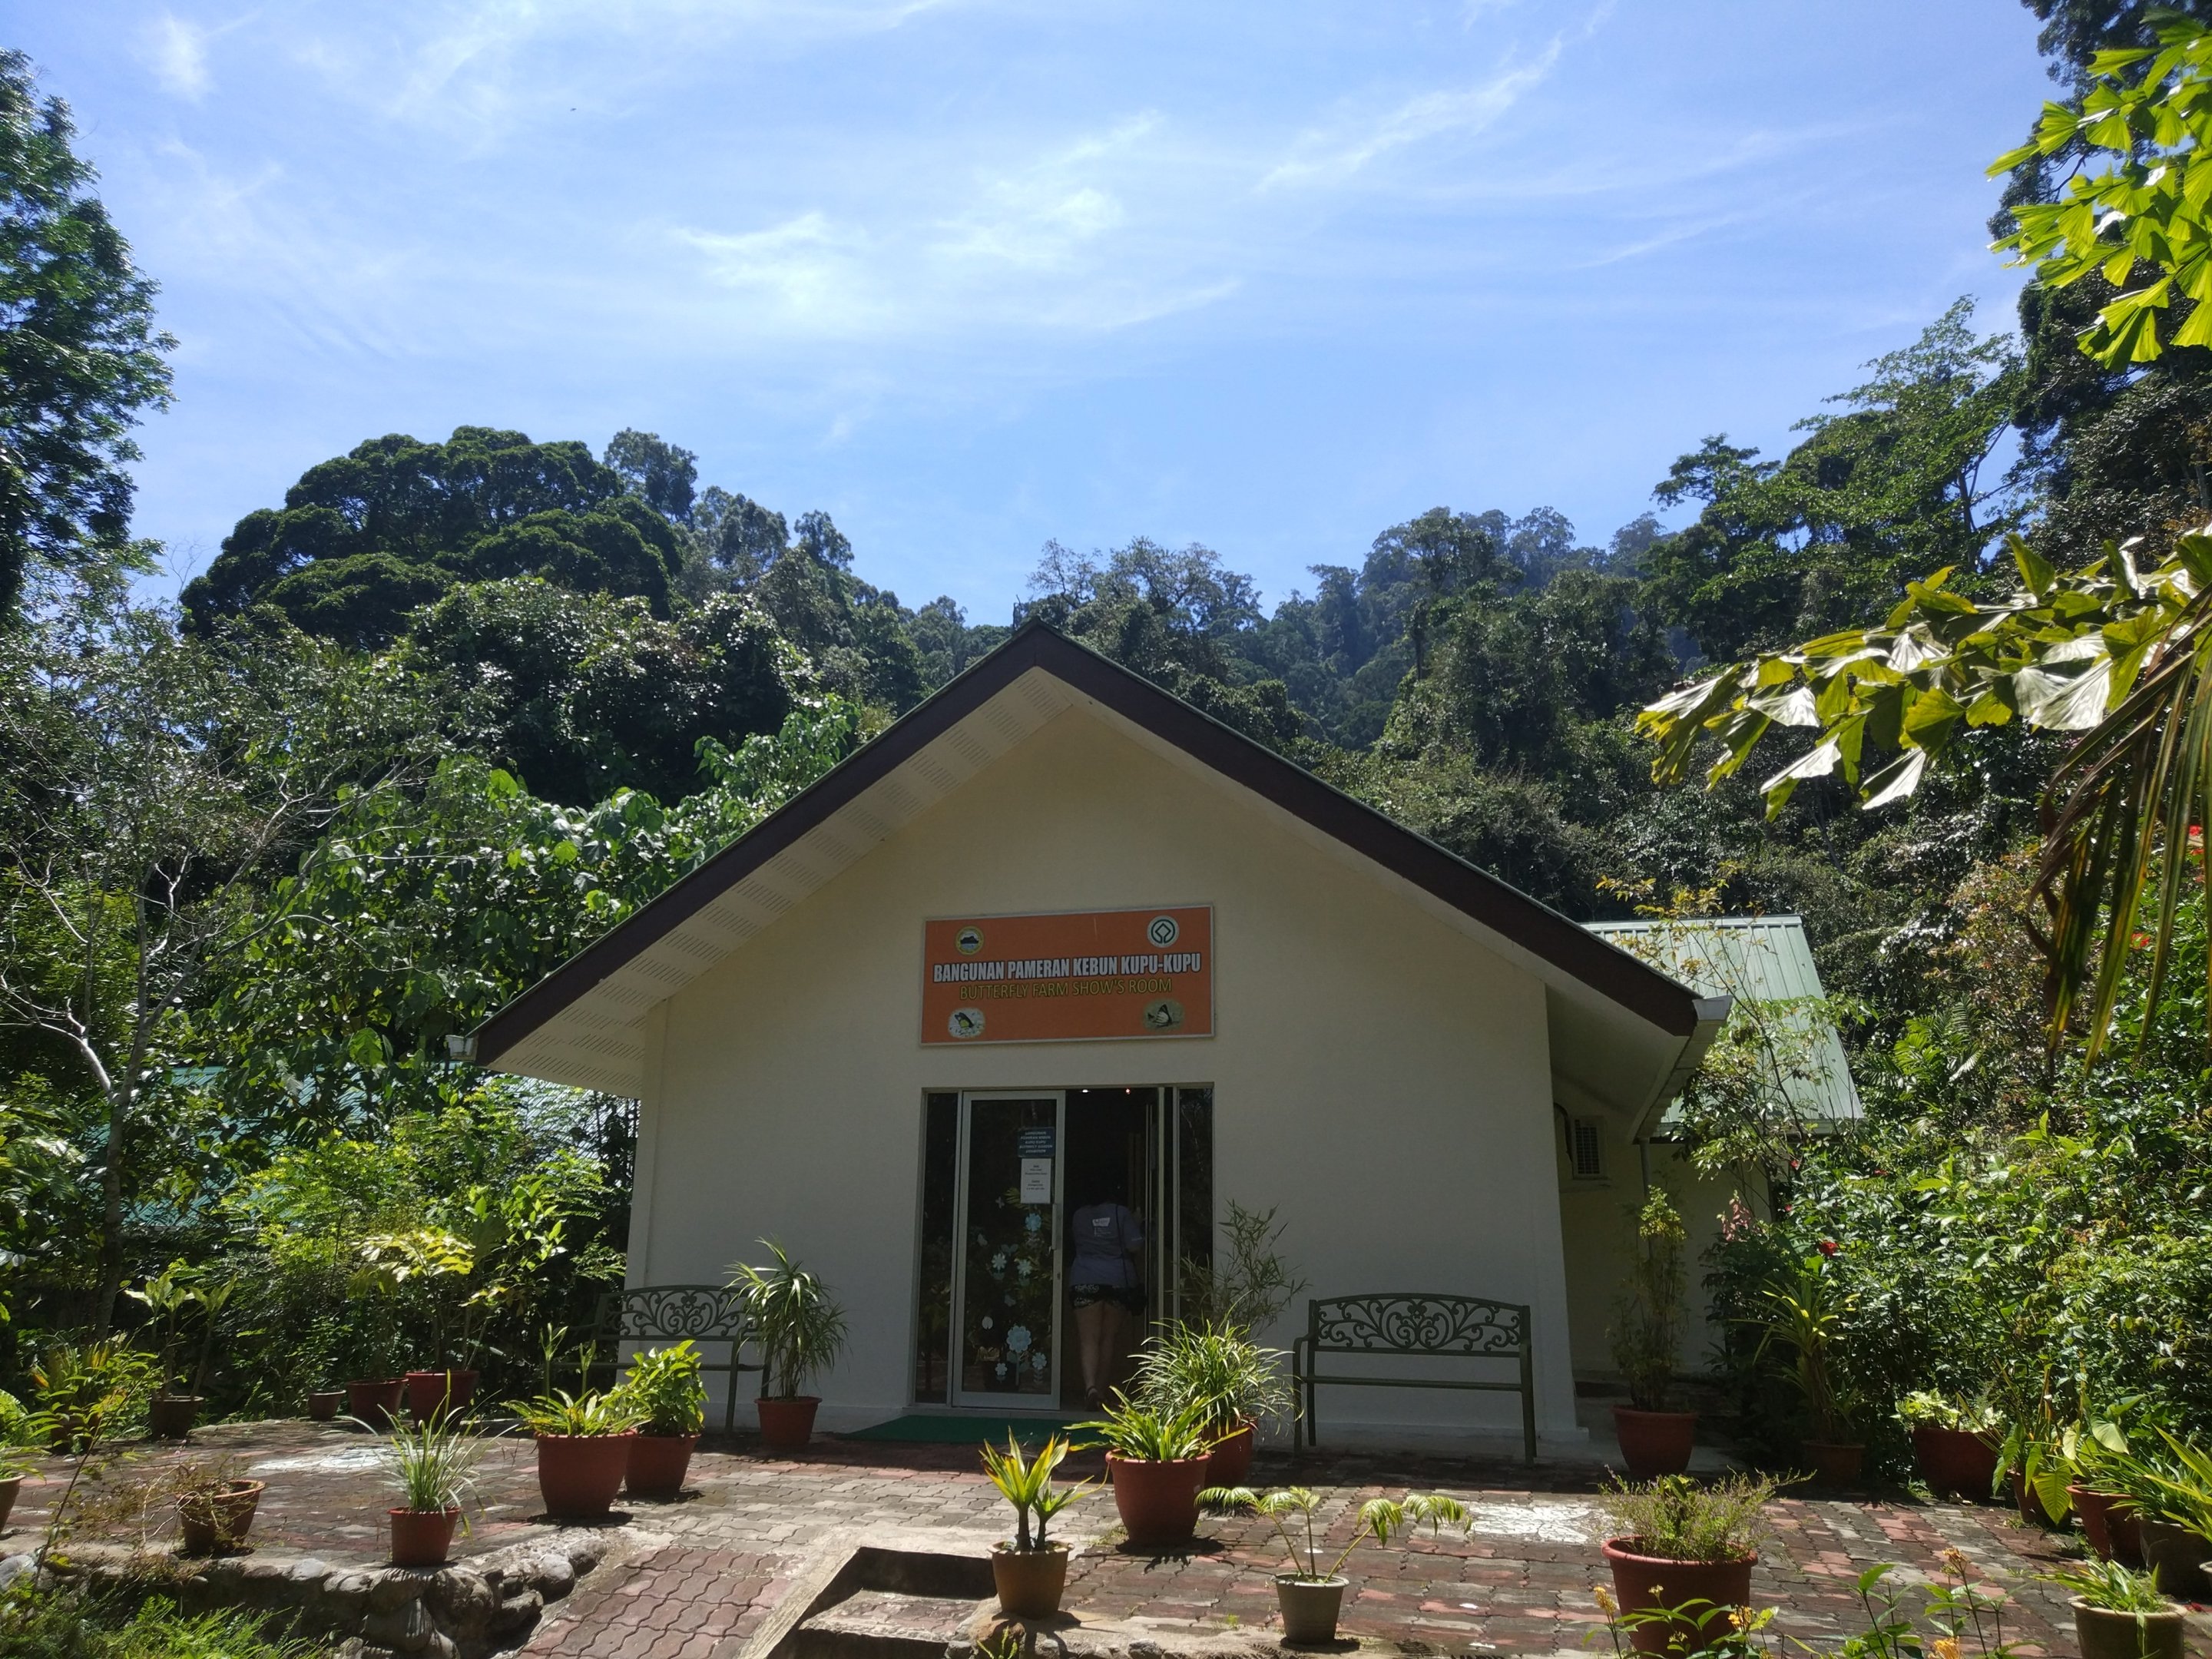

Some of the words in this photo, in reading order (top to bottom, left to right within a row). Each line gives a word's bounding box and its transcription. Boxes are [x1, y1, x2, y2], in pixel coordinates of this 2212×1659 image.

[934, 962, 1004, 982] BANGUNAN
[1008, 959, 1069, 979] PAMERAN
[1073, 956, 1117, 977] KEBUN
[1121, 953, 1201, 975] KUPU-KUPU
[960, 983, 1028, 1000] BUTTERFLY
[1032, 982, 1068, 997] FARM
[1073, 980, 1124, 995] SHOW'S
[1129, 978, 1172, 993] ROOM
